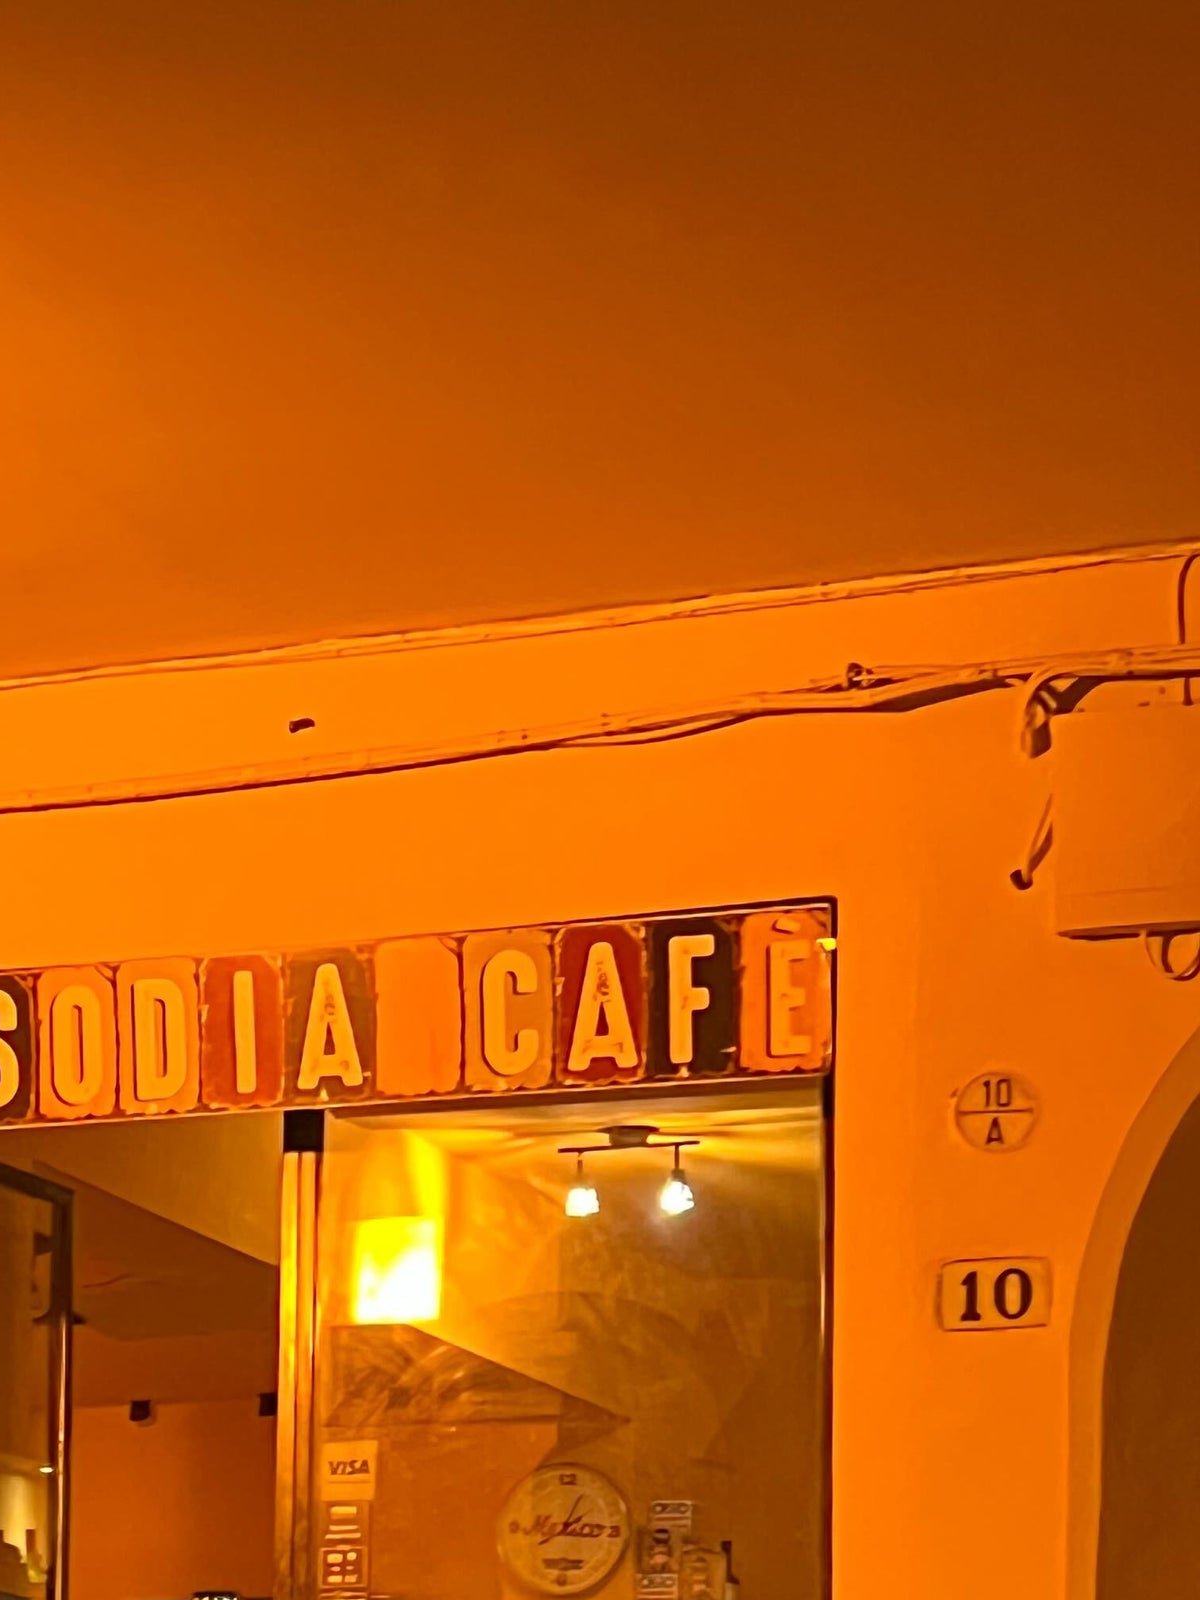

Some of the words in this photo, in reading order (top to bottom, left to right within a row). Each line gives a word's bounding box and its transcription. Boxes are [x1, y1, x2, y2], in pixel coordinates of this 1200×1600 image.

[982, 1078, 1012, 1109] 10
[985, 1116, 1004, 1145] A
[960, 1267, 1033, 1322] 10
[328, 1459, 370, 1476] VISA
